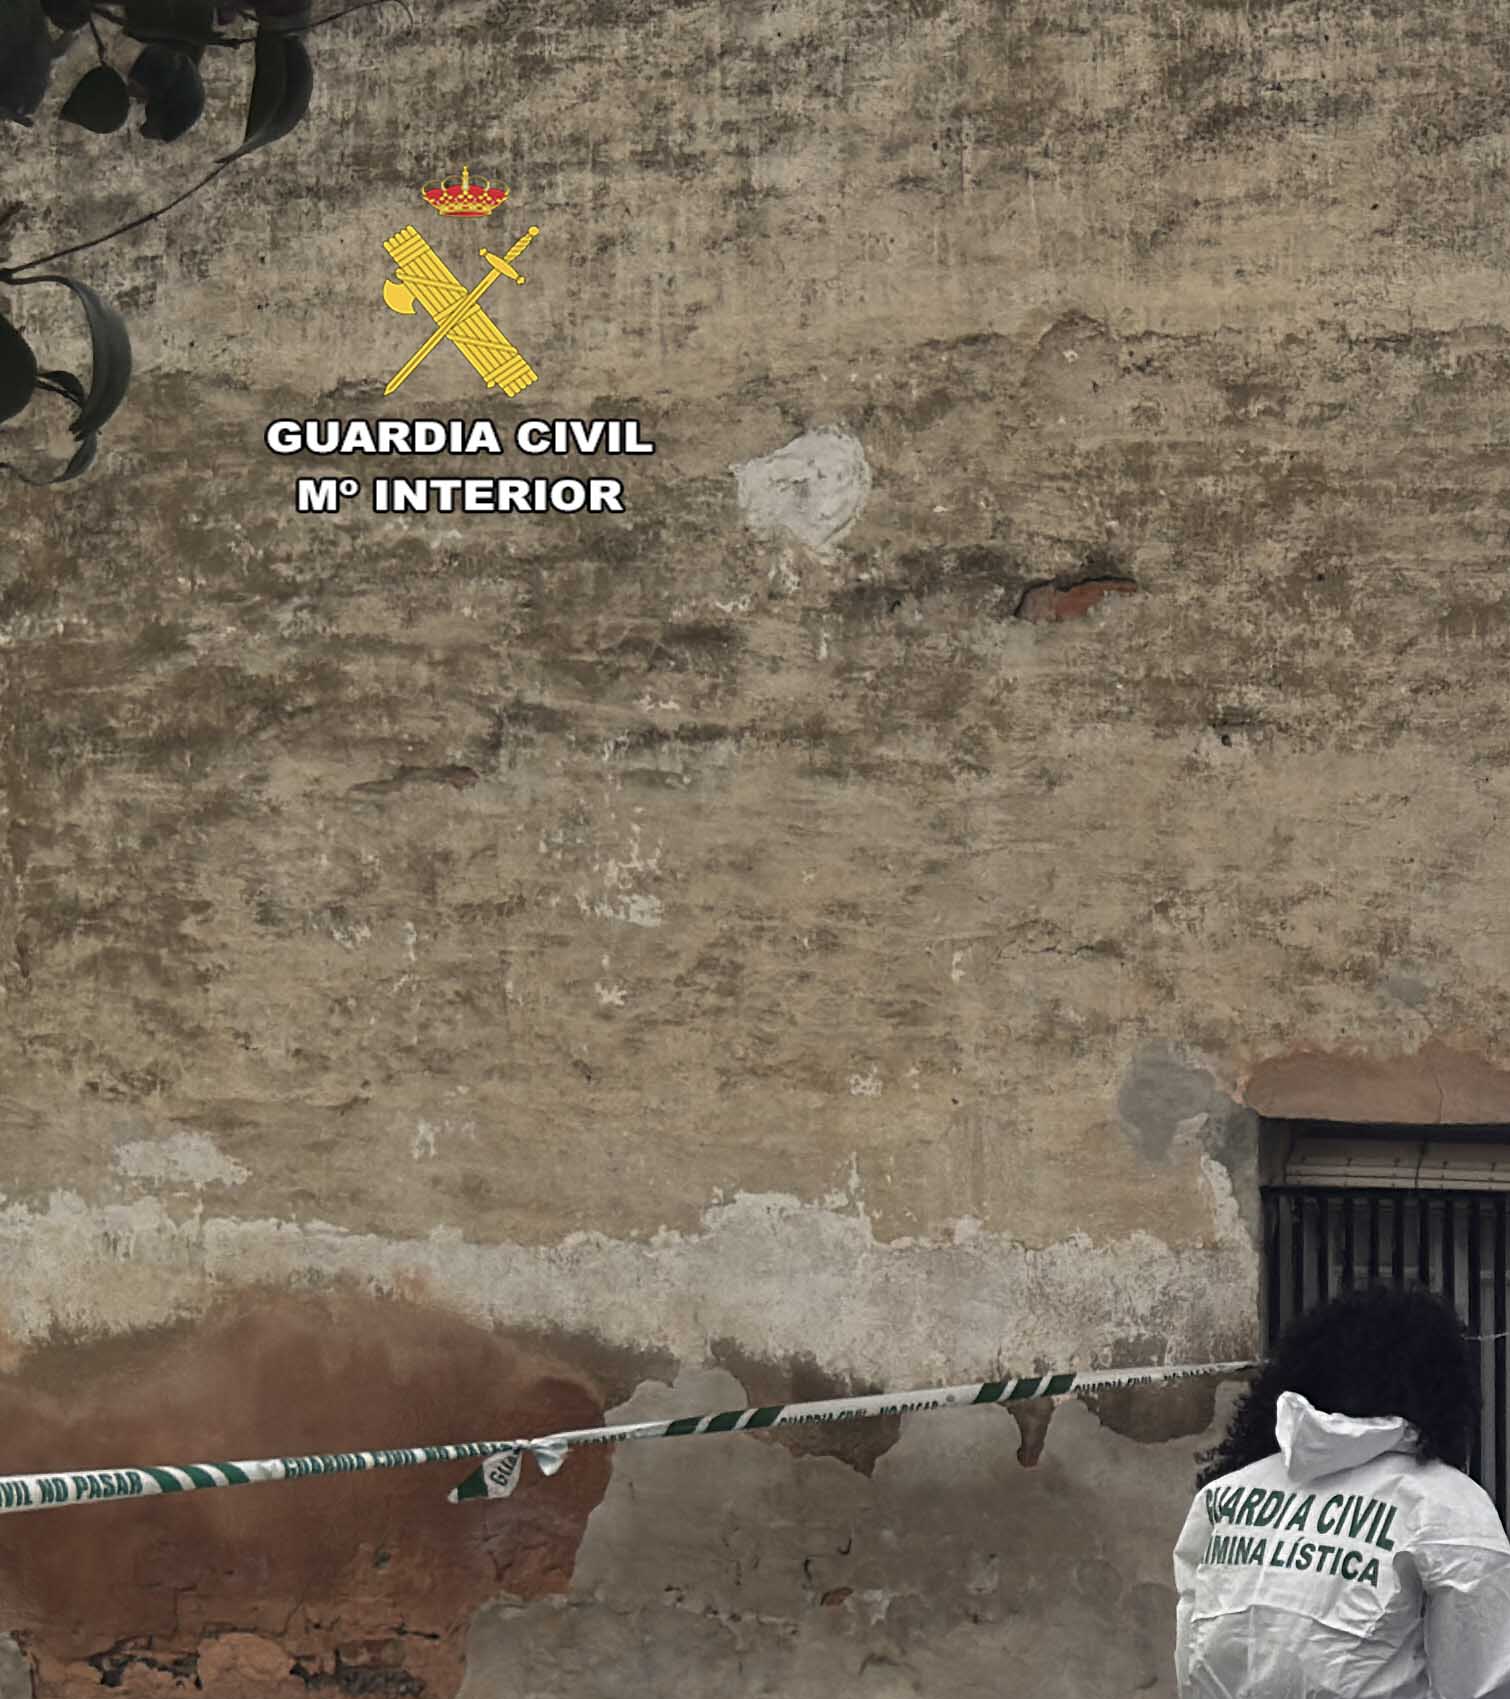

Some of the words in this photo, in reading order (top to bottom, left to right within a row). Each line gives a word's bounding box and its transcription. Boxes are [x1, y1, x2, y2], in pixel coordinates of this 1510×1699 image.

[36, 1478, 69, 1504] NO
[71, 1470, 144, 1501] PASAR
[1316, 1493, 1399, 1552] CIVIL
